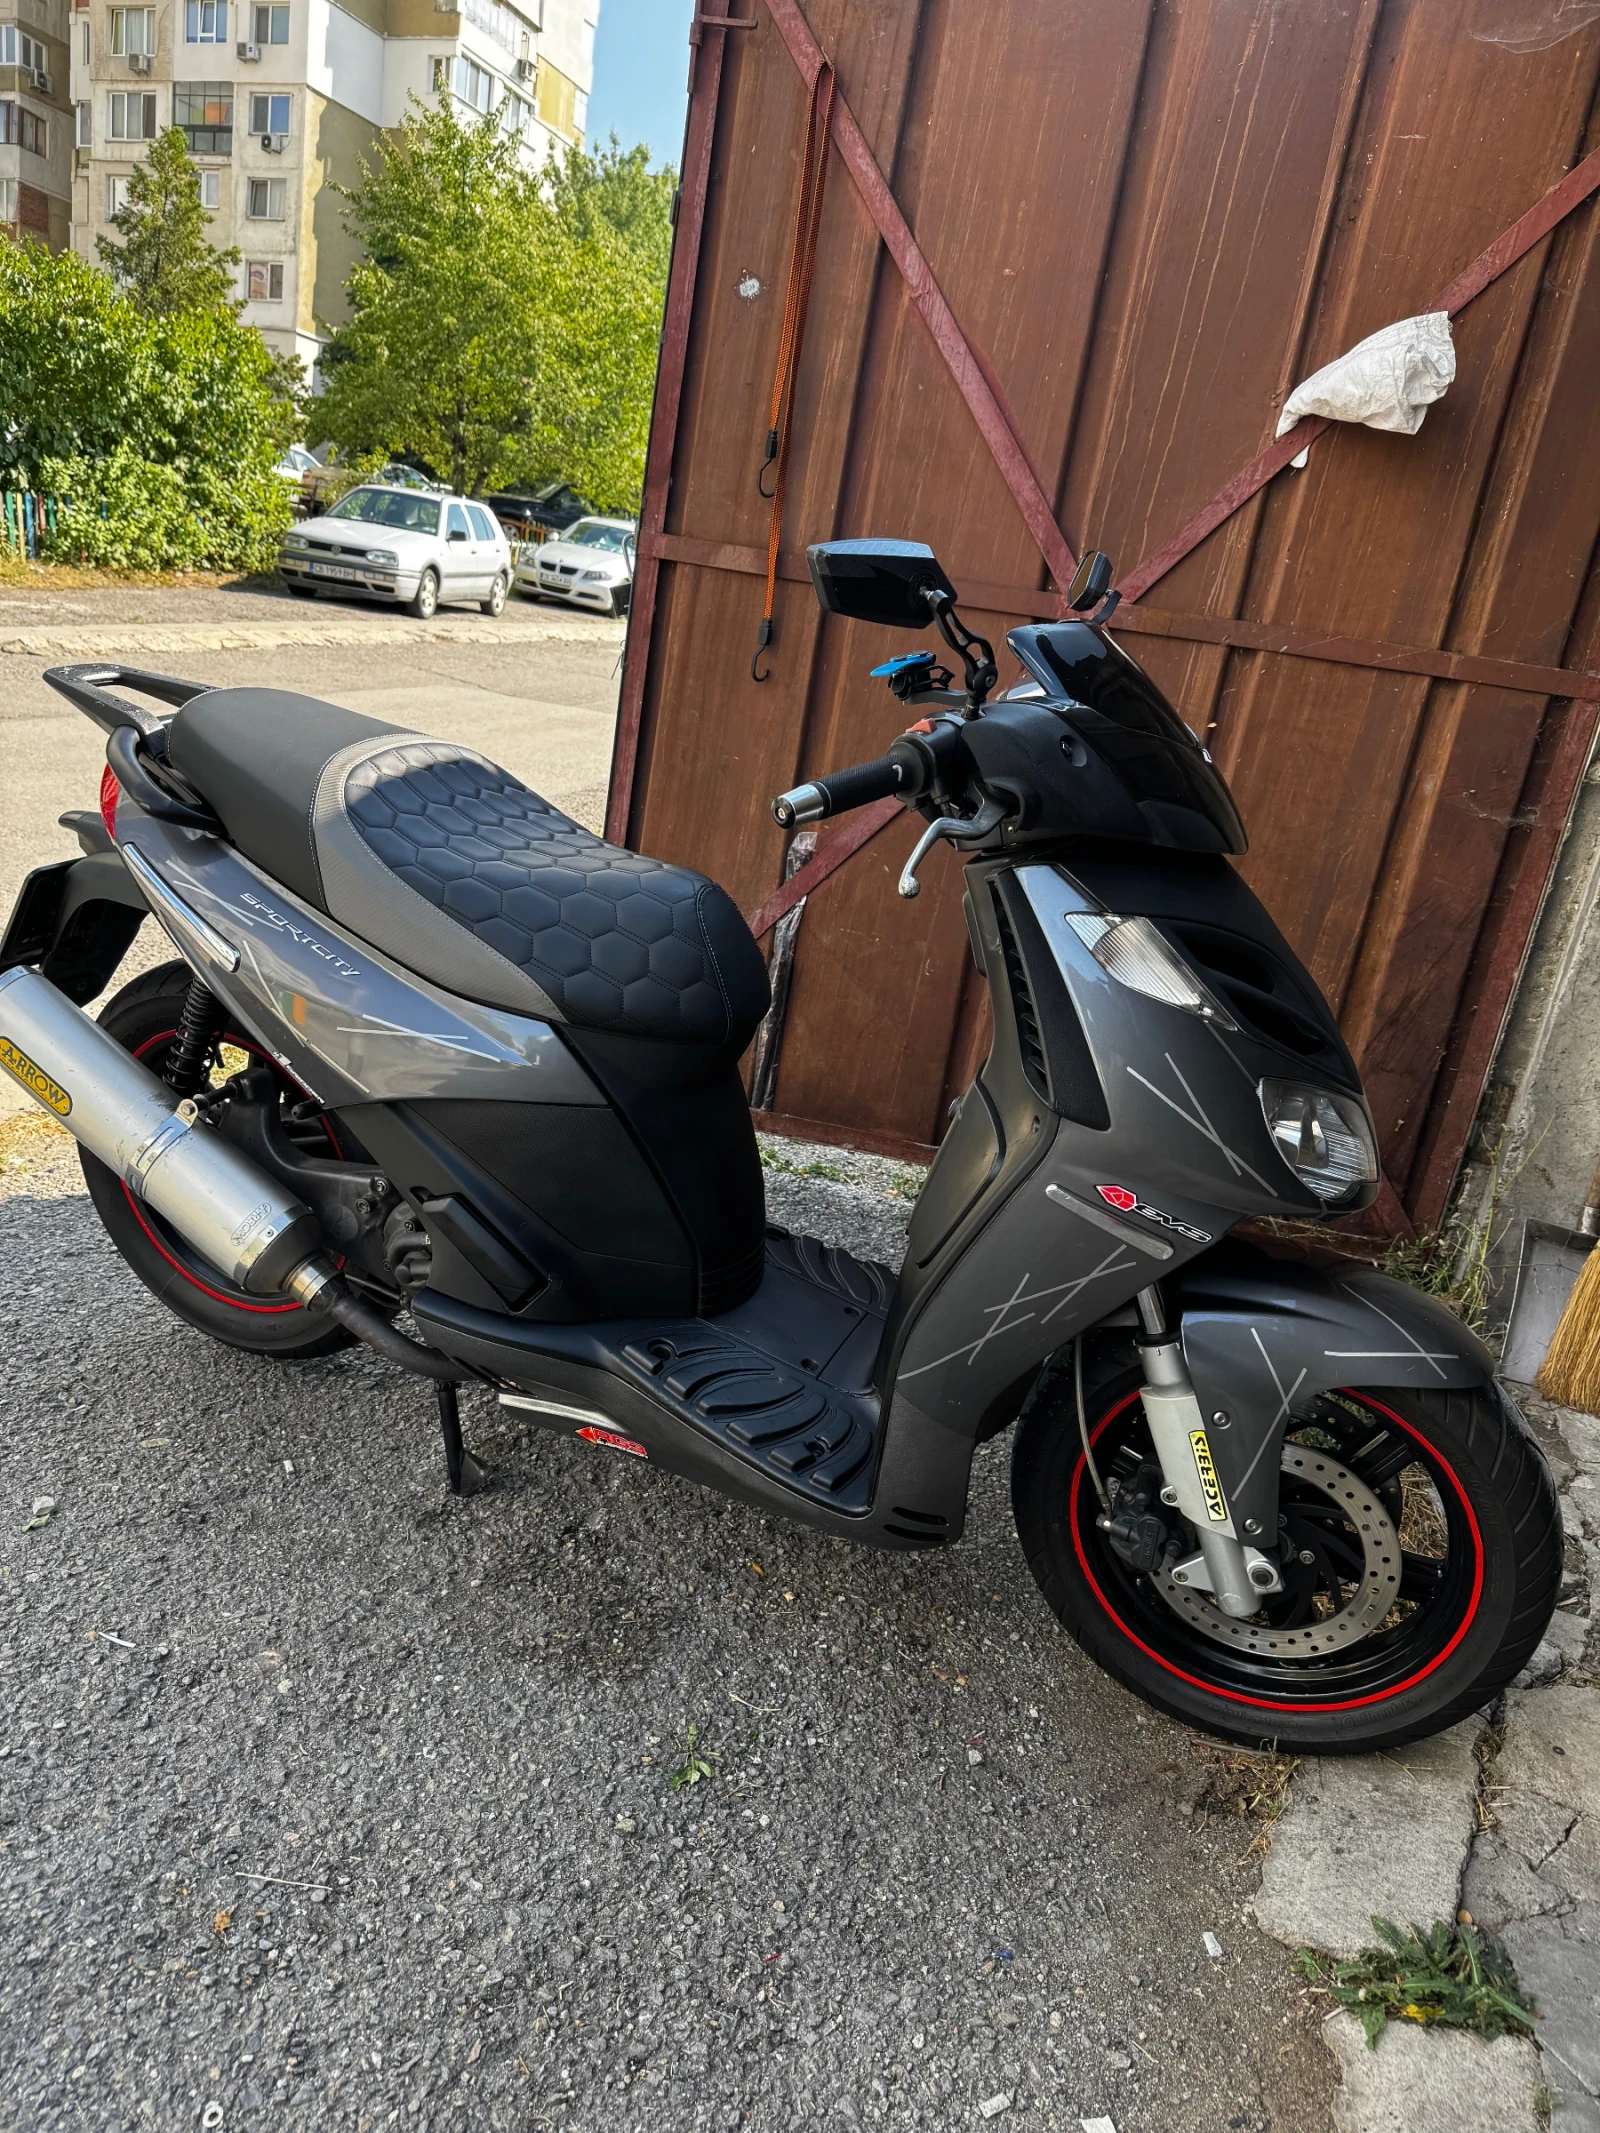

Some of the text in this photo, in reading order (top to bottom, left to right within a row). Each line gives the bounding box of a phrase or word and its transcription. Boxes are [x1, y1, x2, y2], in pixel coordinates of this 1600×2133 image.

[1, 1044, 67, 1105] ARROW
[234, 1204, 271, 1243] ARROW
[1135, 1203, 1212, 1243] EVS
